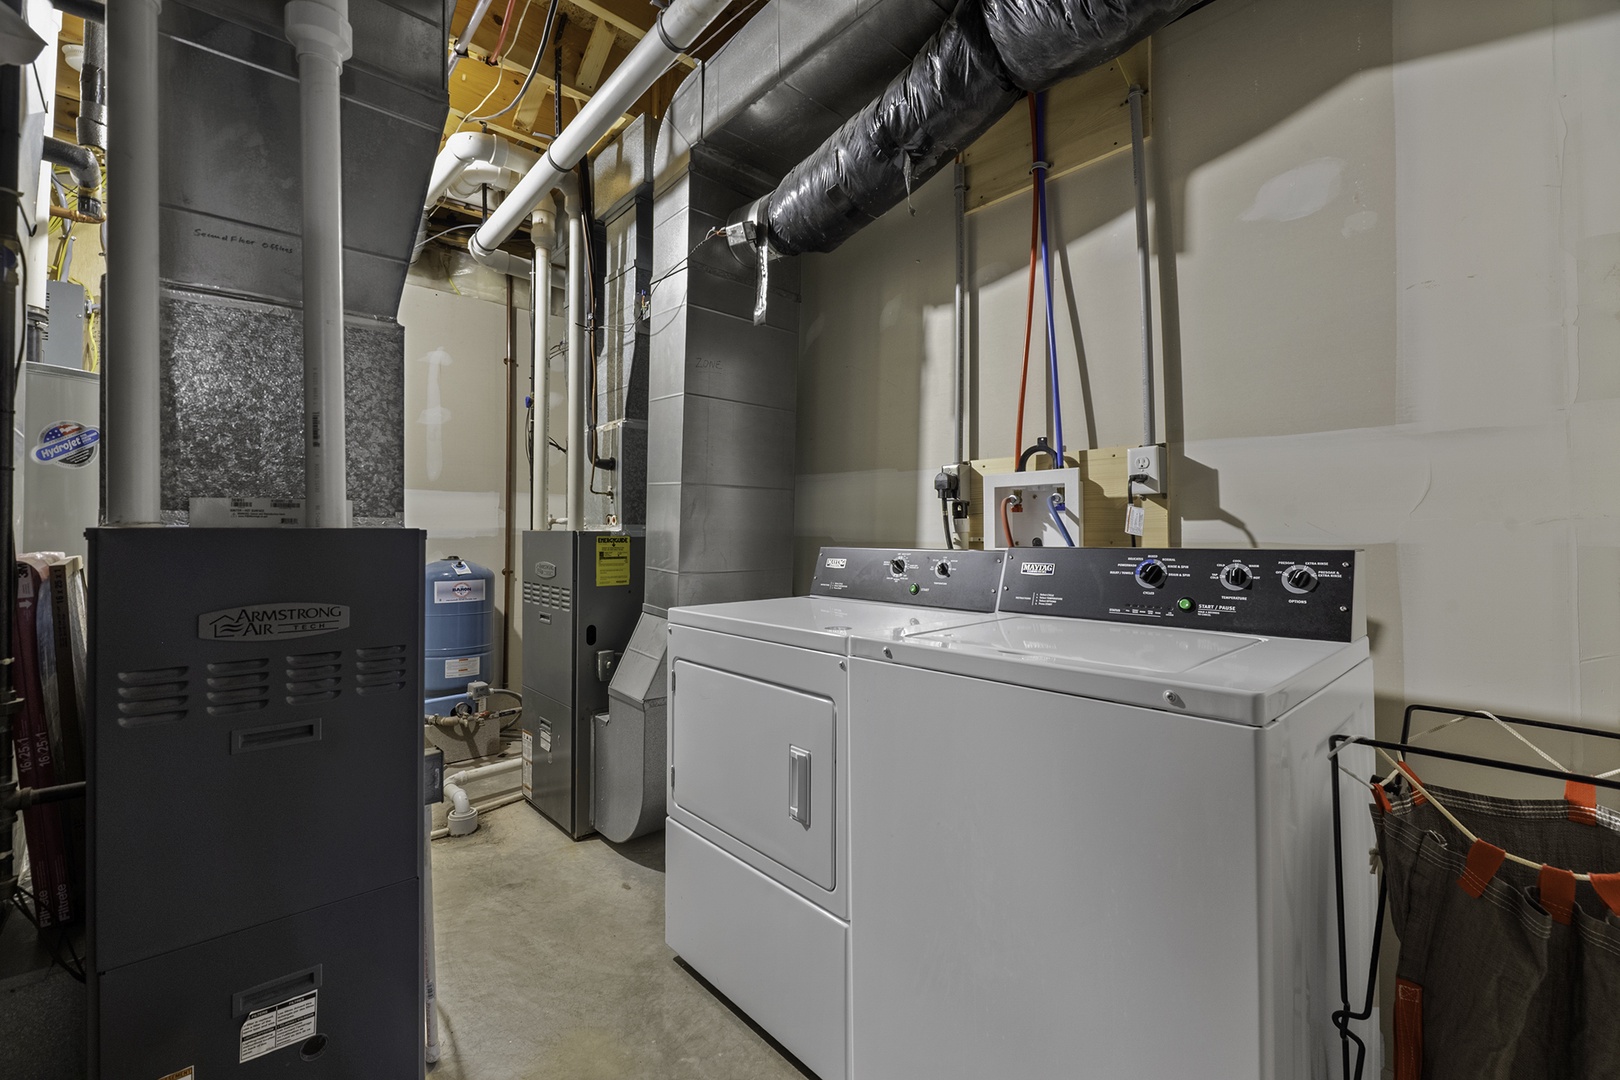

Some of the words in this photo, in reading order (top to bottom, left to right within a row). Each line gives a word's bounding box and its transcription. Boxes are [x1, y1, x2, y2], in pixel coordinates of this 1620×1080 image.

[41, 437, 81, 459] Hydrojet
[235, 606, 342, 624] ARMSTRONG
[242, 622, 274, 637] AIR
[293, 623, 326, 631] TECH
[56, 883, 71, 922] Filtrete
